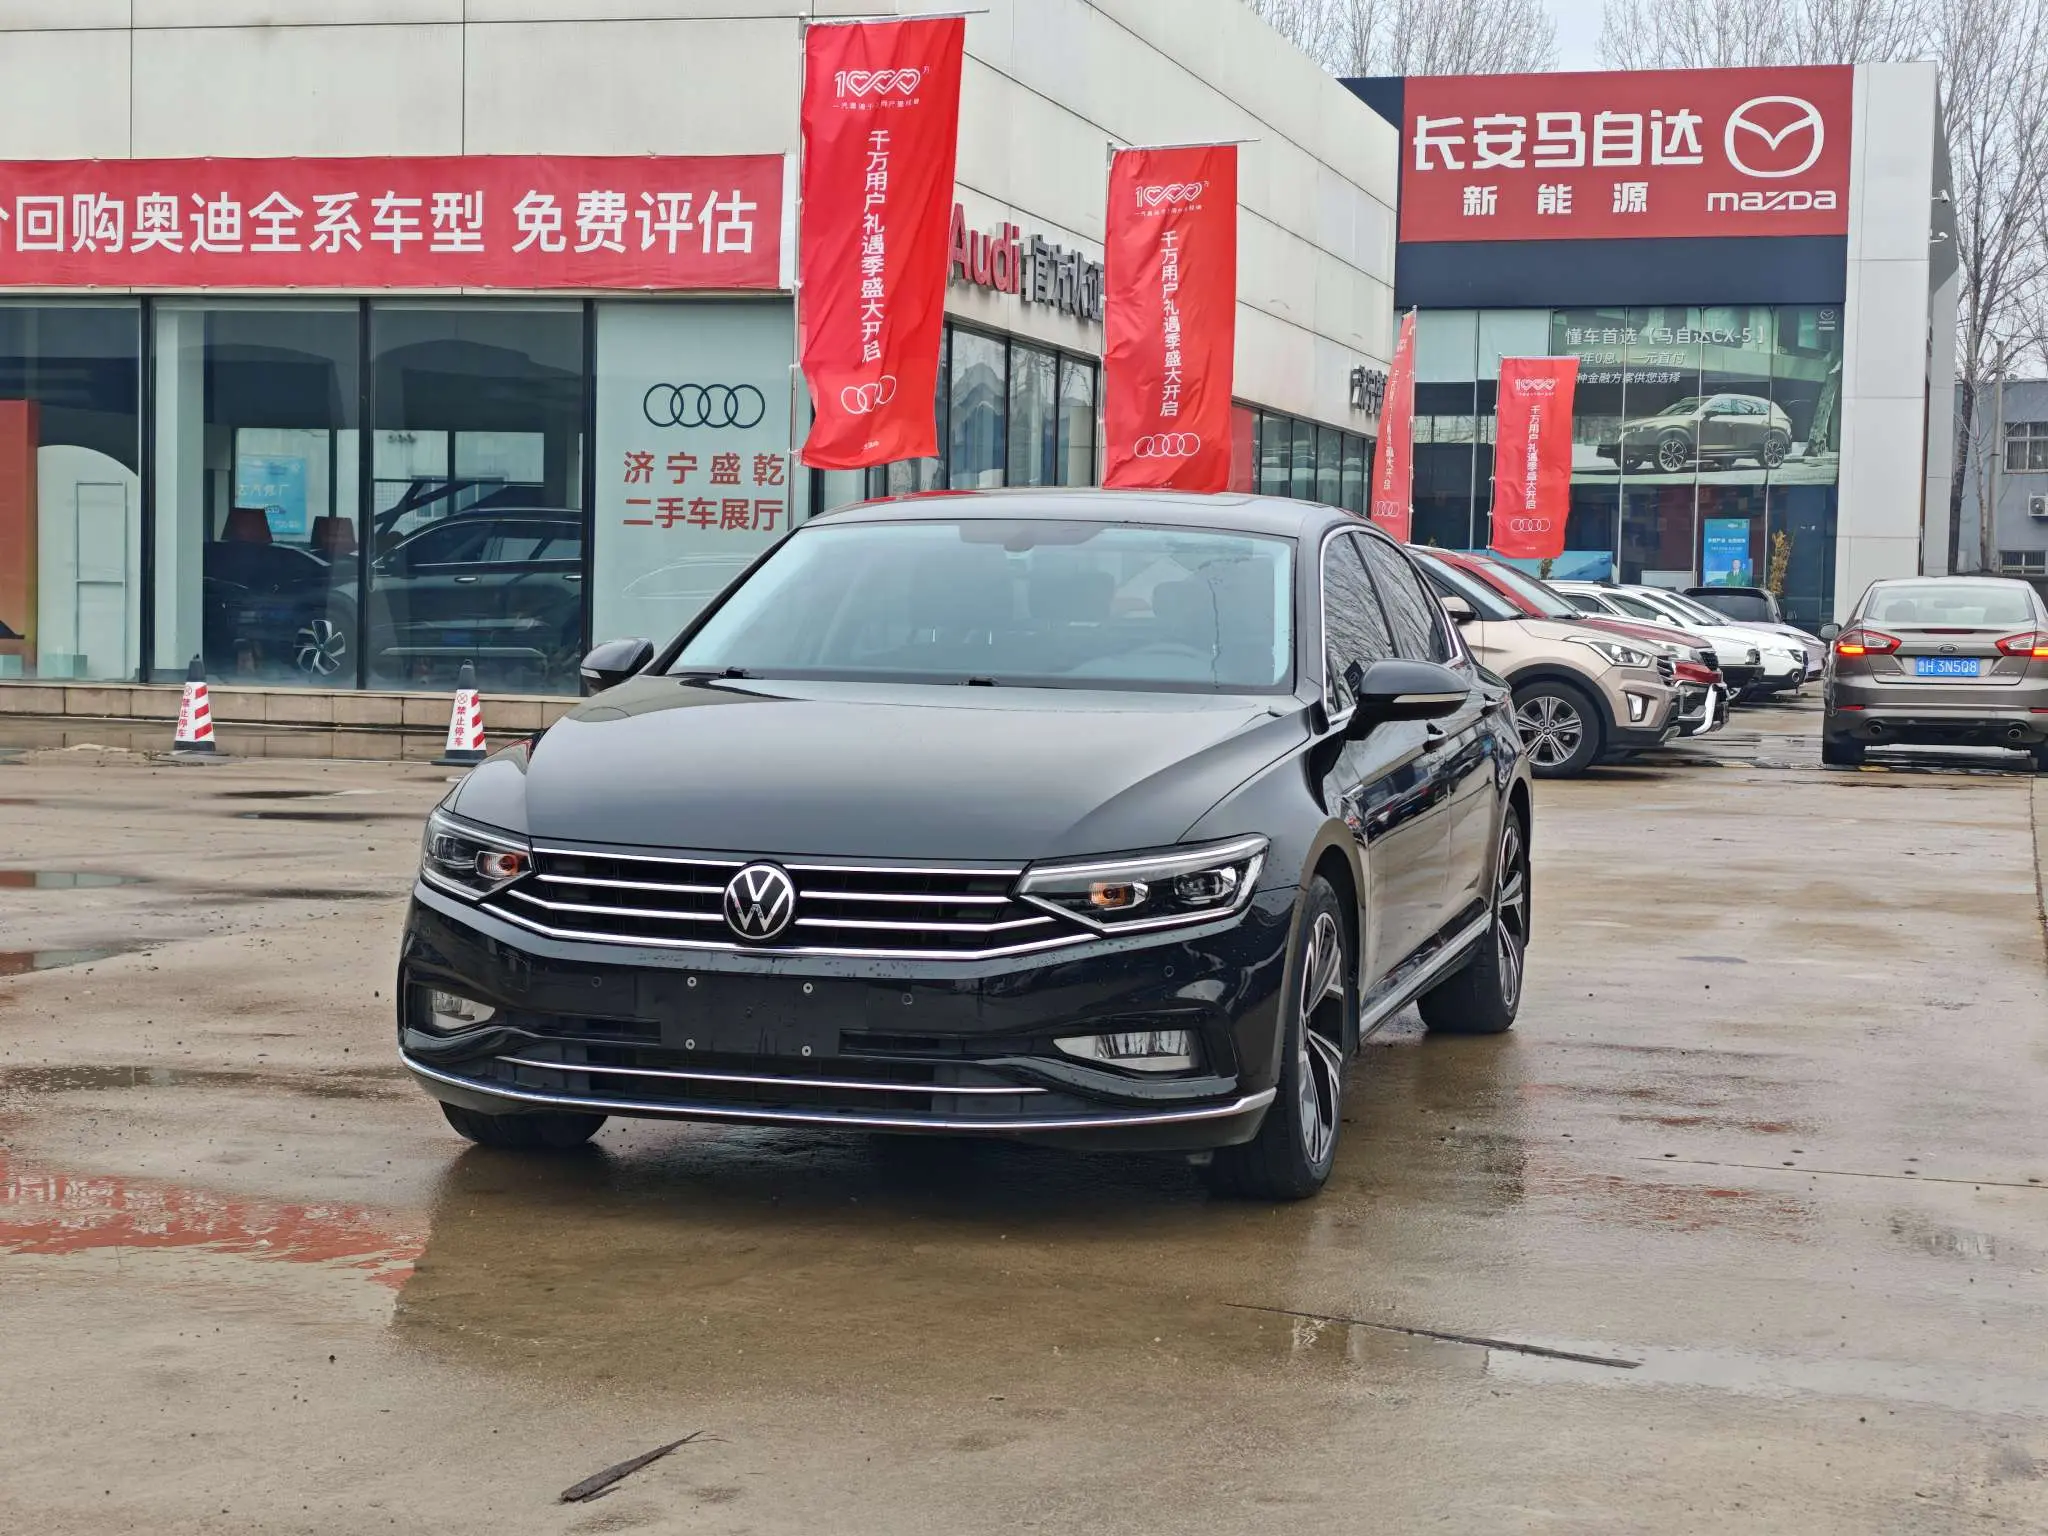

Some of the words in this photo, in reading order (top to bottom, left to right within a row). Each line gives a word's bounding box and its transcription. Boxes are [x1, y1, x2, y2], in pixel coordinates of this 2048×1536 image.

[1413, 108, 1704, 171] 长安马自达
[0, 189, 485, 254] 回购奥迪全系车型
[511, 189, 758, 255] 免费评估
[1463, 182, 1649, 217] 新能源
[859, 129, 891, 363] 千万用户礼遇季盛大开启
[949, 202, 1020, 295] Audi
[1159, 230, 1183, 418] 千万用户礼遇季盛大开启
[623, 450, 785, 487] 济宁盛乾
[622, 496, 784, 532] 二手车展厅
